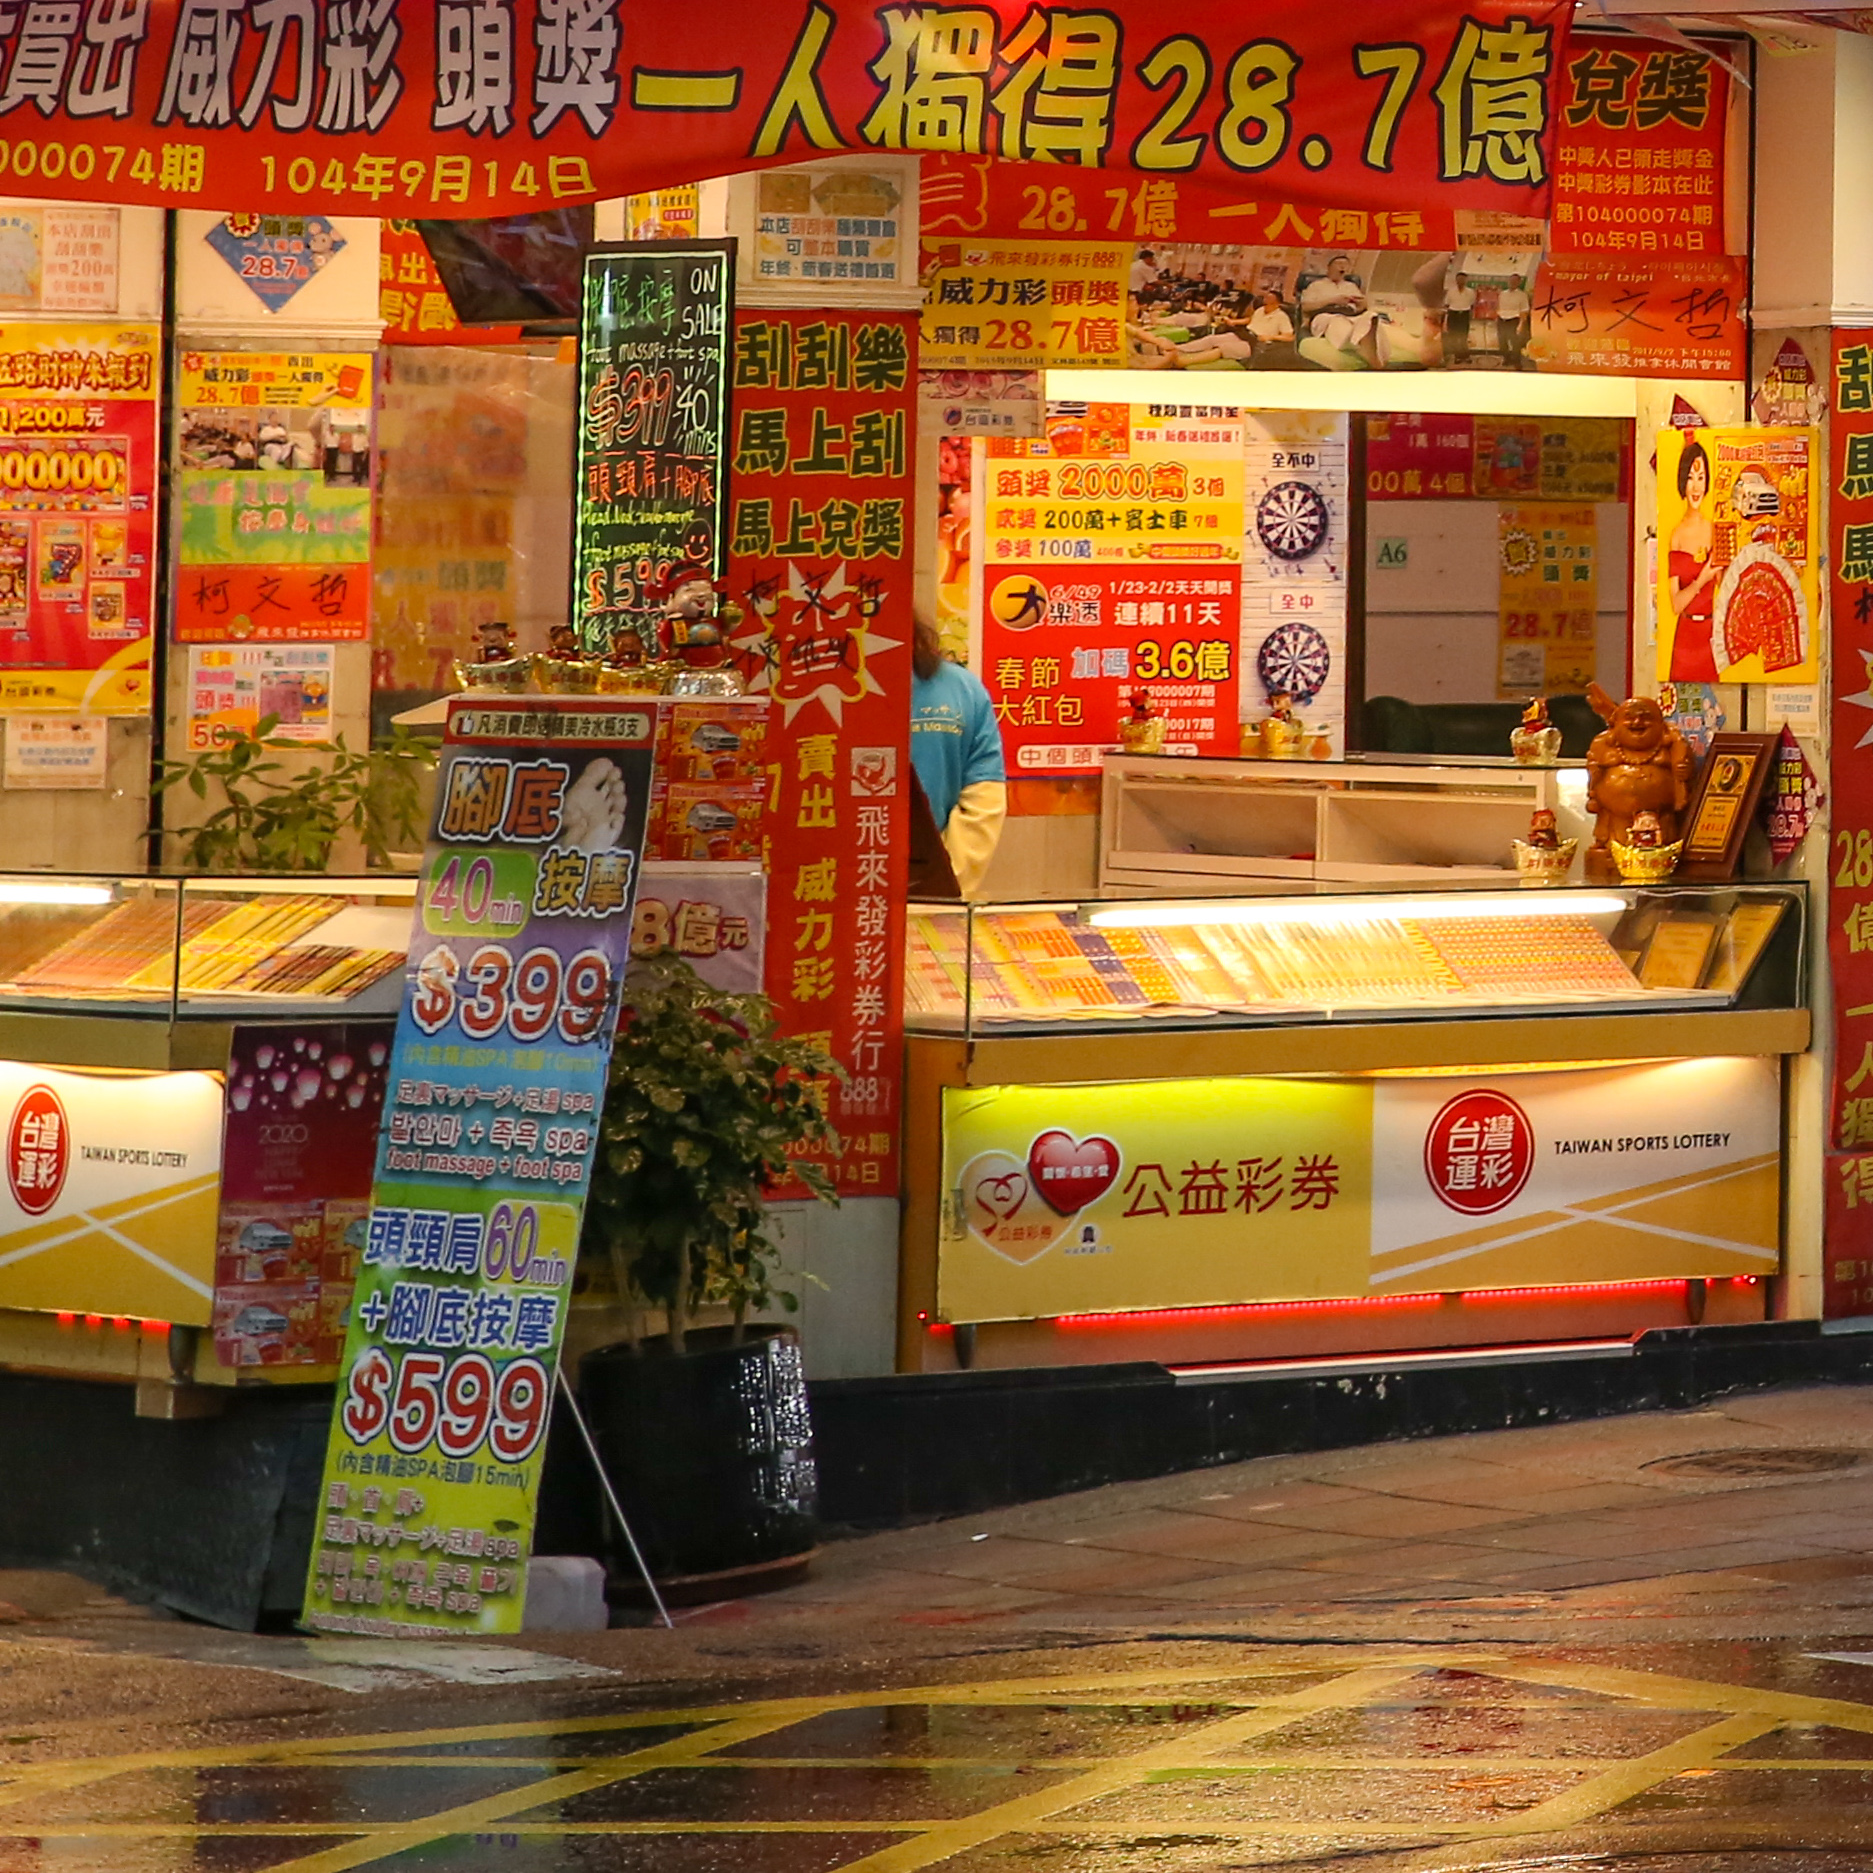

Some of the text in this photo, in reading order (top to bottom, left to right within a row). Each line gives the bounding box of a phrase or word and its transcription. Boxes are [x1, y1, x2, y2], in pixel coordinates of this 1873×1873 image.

[1564, 48, 1711, 131] 兌獎
[1559, 146, 1714, 170] 中獎人已領走獎金
[260, 153, 597, 205] 104年9月14日
[1557, 173, 1713, 196] 中獎彩券影本在此
[1018, 180, 1178, 239] 28.7億
[1556, 204, 1713, 225] 第104000074期
[1570, 231, 1704, 252] 104年9月14日
[690, 267, 717, 294] ON
[682, 304, 724, 340] SALE
[735, 319, 908, 393] 刮刮樂
[732, 406, 906, 478] 馬上刮
[1271, 452, 1317, 469] 全不中
[1058, 463, 1188, 501] 2000萬
[730, 496, 903, 561] 馬上兌獎
[1039, 540, 1091, 559] 100萬
[1380, 542, 1406, 563] A6
[1114, 602, 1221, 626] 連續11天
[1282, 595, 1314, 609] 全中
[996, 657, 1060, 689] 春節
[1135, 641, 1231, 682] 3.6億
[994, 695, 1084, 727] 大紅包
[439, 757, 570, 842] 腳底
[532, 845, 634, 918] 按摩
[851, 804, 888, 1072] 飛來發彩券行
[410, 942, 608, 1044] $399
[390, 1113, 589, 1154] 발안마 족욕 spa
[1554, 1131, 1731, 1155] TAIWAN SPORTS LOTTERY
[81, 1146, 188, 1169] TAIWAN SPORTS LOTTERY
[425, 1153, 495, 1179] massage
[1120, 1155, 1341, 1221] 公益彩券
[364, 1206, 484, 1275] 頭頸肩
[343, 1345, 549, 1463] $599
